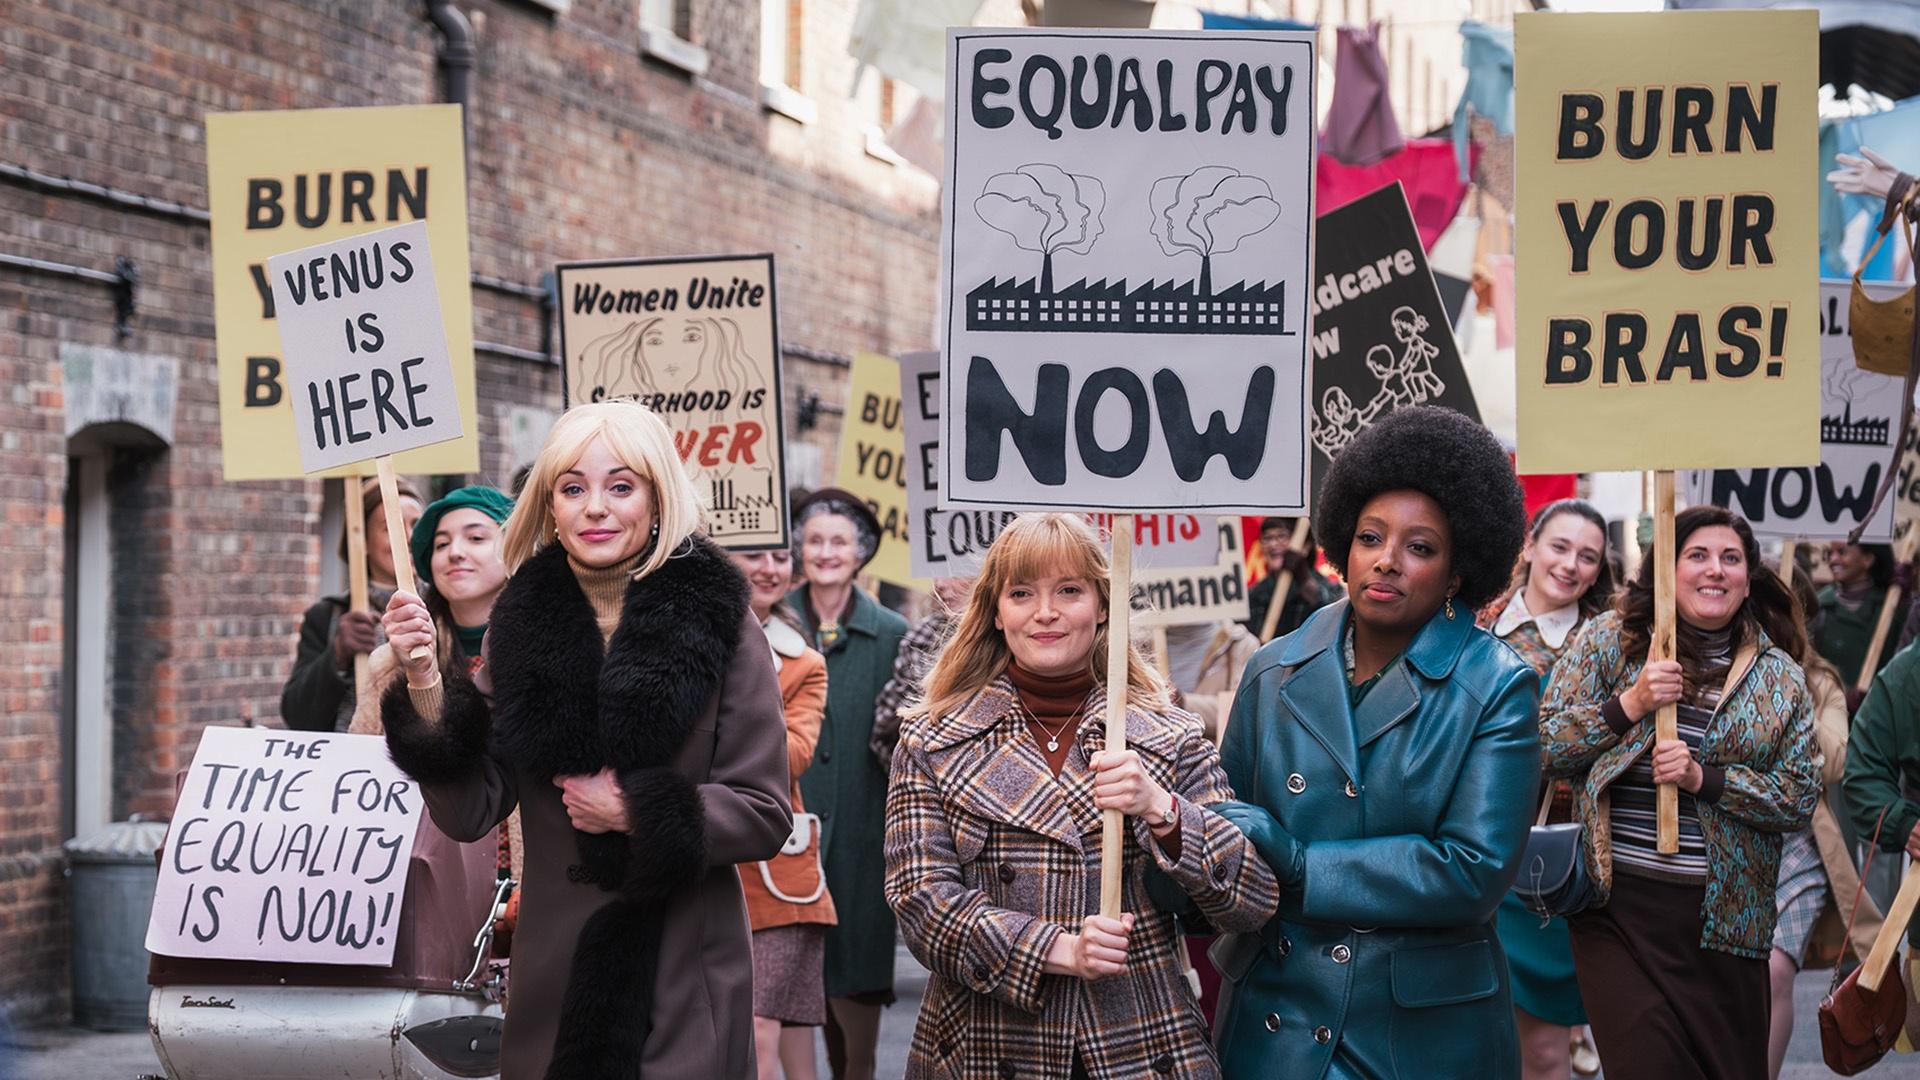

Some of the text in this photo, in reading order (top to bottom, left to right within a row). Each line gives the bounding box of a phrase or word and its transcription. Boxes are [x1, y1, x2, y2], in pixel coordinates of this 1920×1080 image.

[971, 48, 1293, 140] EQUAL PAY
[1555, 83, 1780, 162] BURN
[246, 167, 428, 230] BURN
[1557, 194, 1775, 273] YOUR
[284, 242, 414, 305] VENUS
[573, 277, 765, 315] Women Unite
[1313, 248, 1417, 316] dcare
[345, 312, 385, 354] IS
[1544, 306, 1790, 384] BRAS!
[308, 357, 434, 450] HERE
[742, 387, 767, 410] IS
[860, 391, 903, 430] BU
[964, 355, 1276, 487] NOW
[1711, 461, 1881, 523] NOW
[1129, 563, 1243, 611] emand
[264, 738, 330, 760] THE
[201, 763, 410, 815] TIME FOR
[174, 817, 404, 884] EQUALITY
[178, 883, 395, 950] IS NOW!
